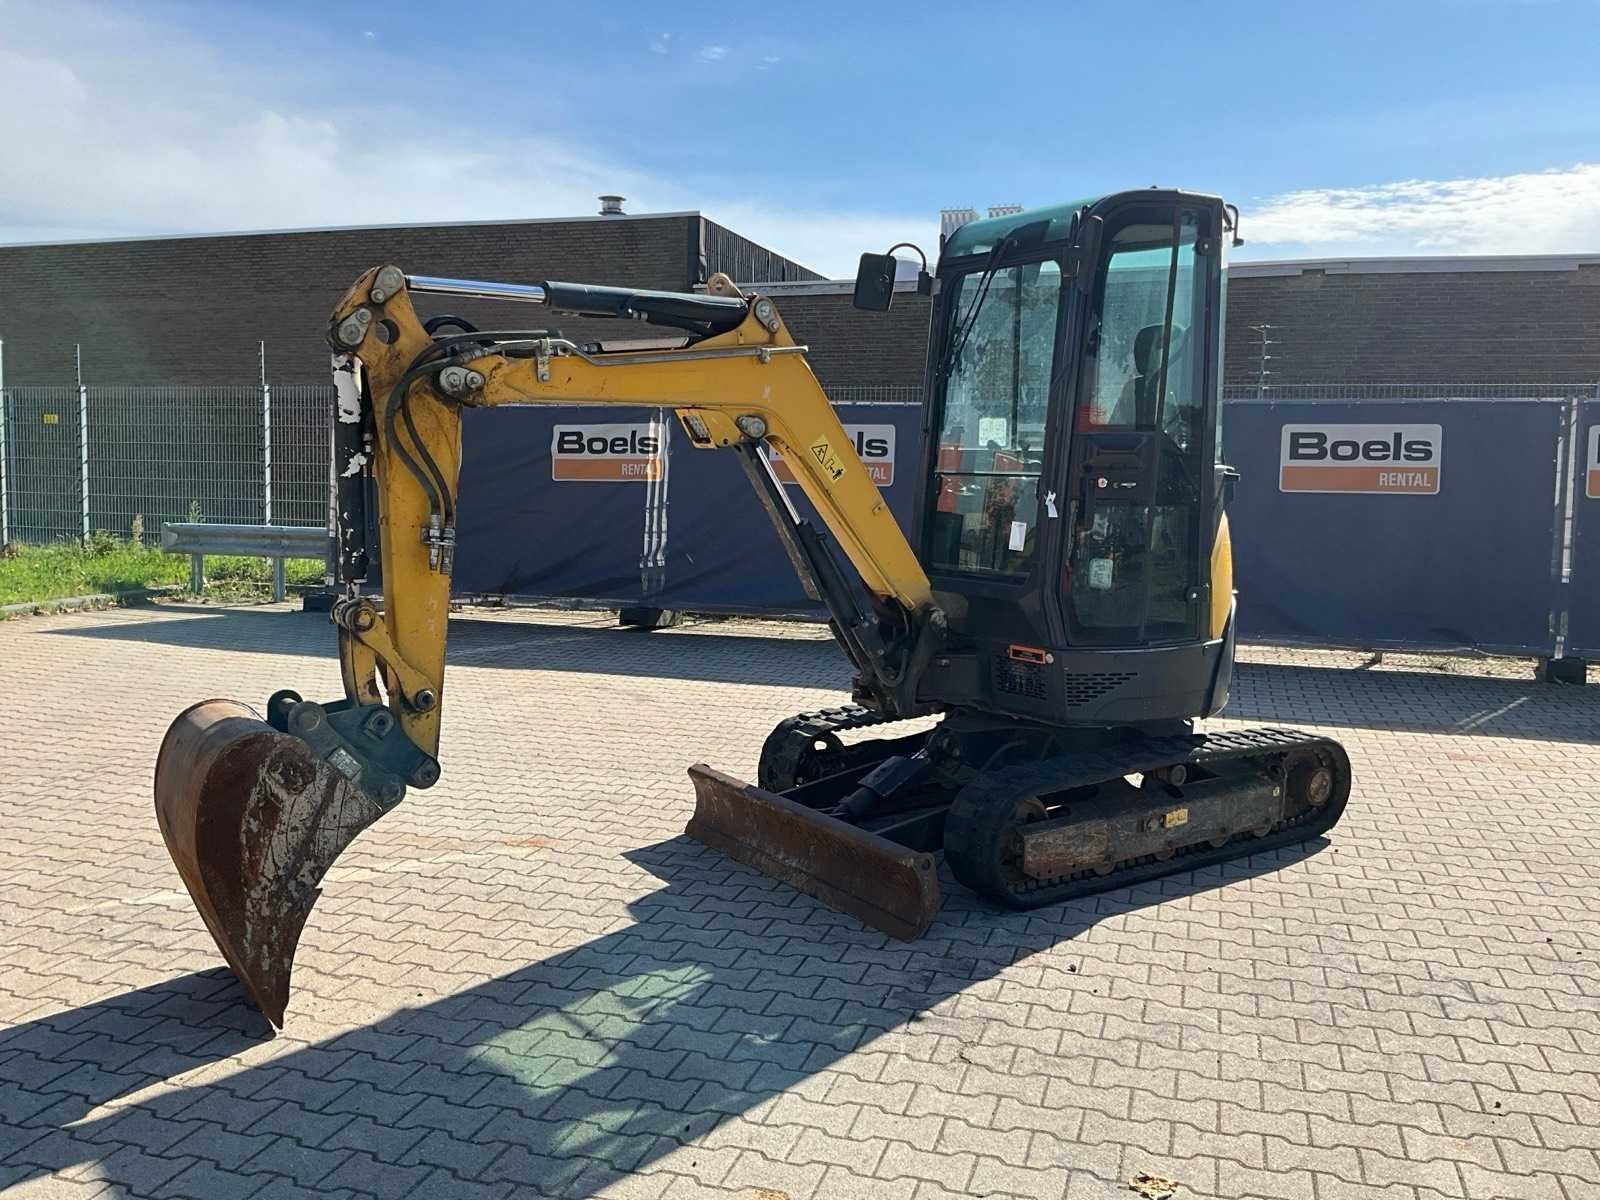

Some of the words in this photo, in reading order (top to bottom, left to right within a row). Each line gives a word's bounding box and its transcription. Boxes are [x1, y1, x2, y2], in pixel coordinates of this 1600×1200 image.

[557, 430, 659, 455] Boels
[1289, 432, 1433, 461] Boels
[1379, 472, 1431, 487] RENTAL
